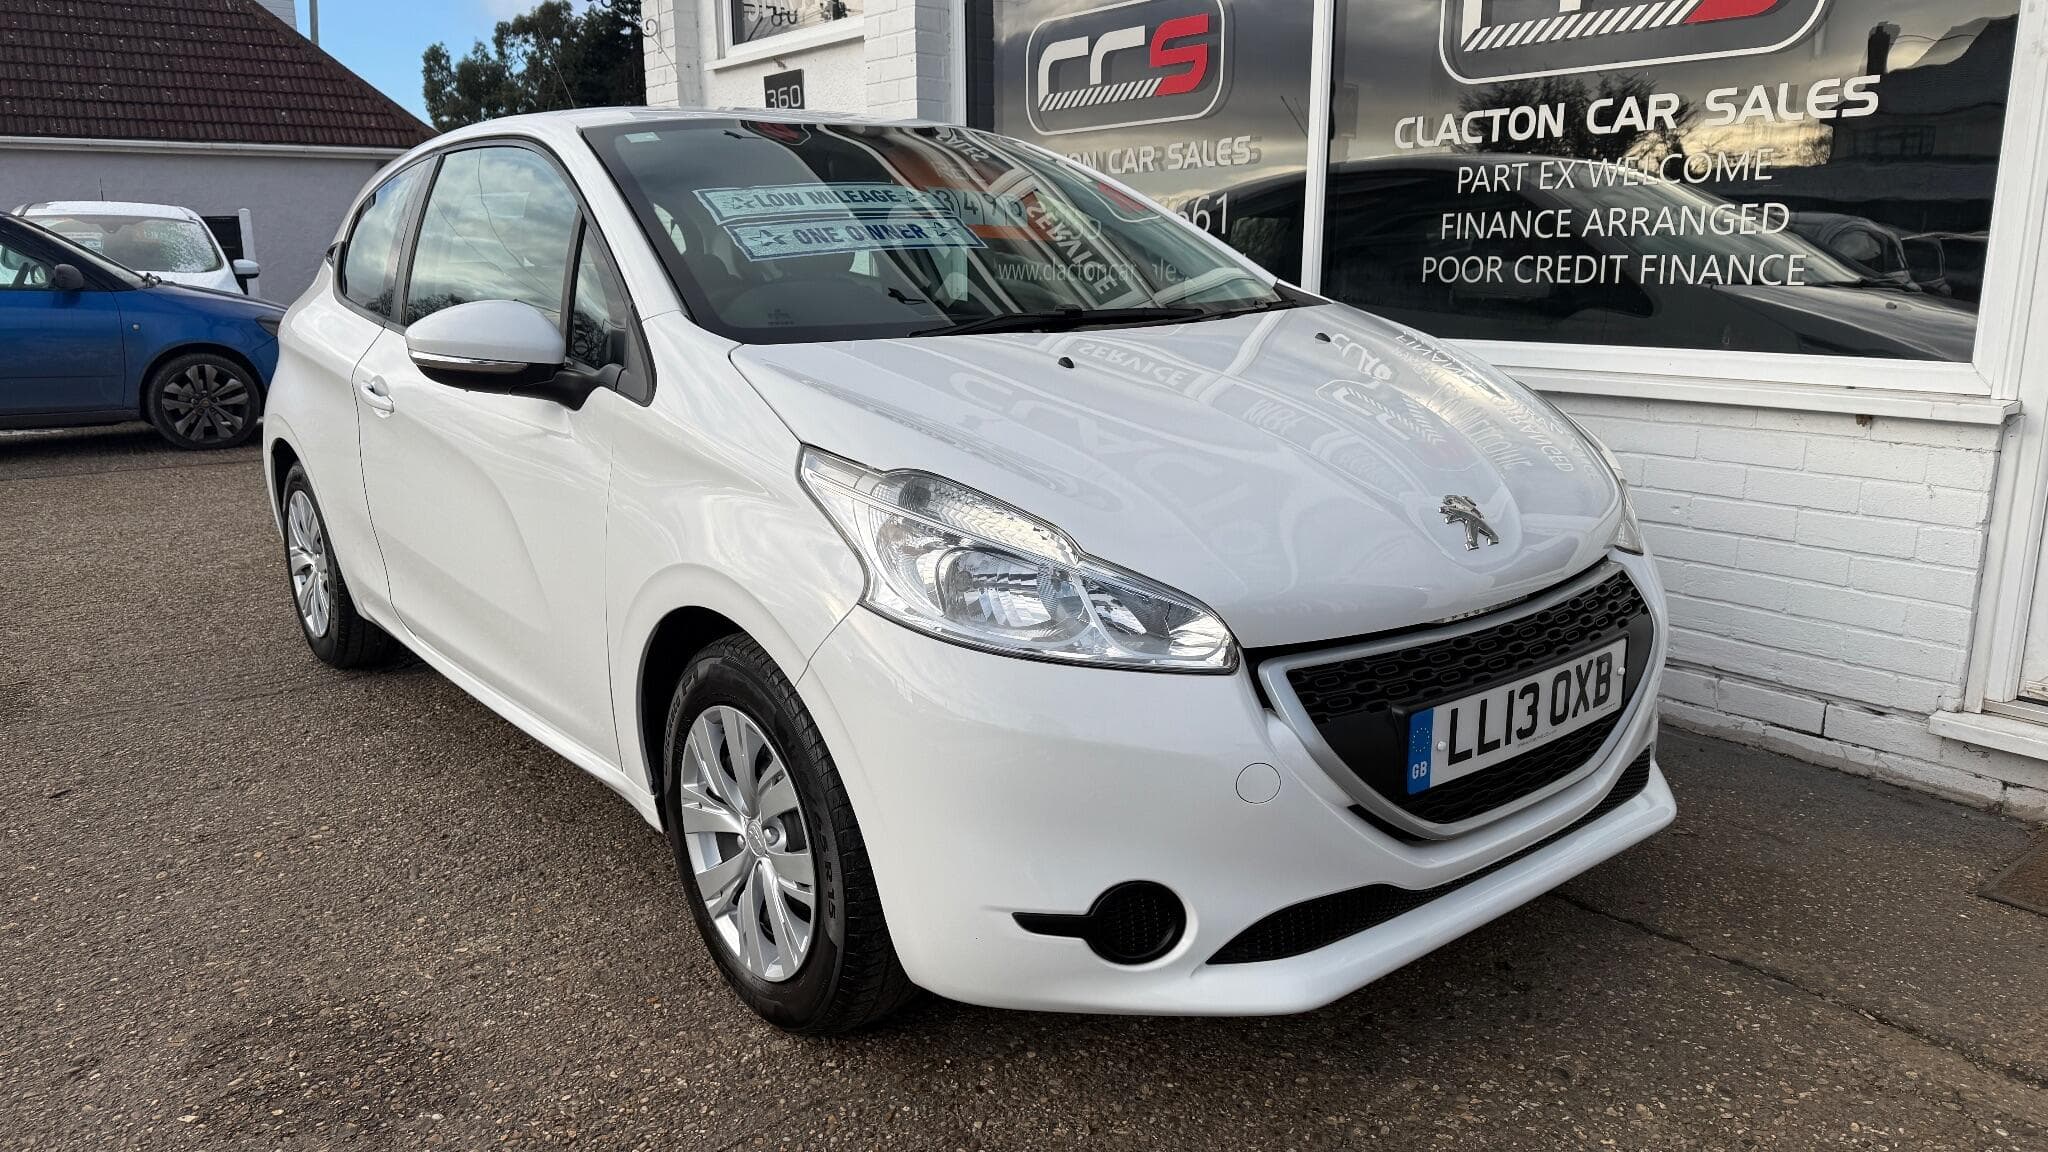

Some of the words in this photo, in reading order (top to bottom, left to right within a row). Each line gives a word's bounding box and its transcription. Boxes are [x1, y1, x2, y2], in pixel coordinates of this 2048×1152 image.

[767, 85, 801, 109] 360
[1394, 103, 1565, 151] CLACTON
[1586, 93, 1679, 136] CAR
[1704, 74, 1881, 127] SALES
[1108, 145, 1156, 174] CAR
[1167, 135, 1251, 170] SALES
[1457, 162, 1529, 194] PART
[1539, 160, 1577, 191] EX
[1588, 148, 1774, 191] WELCOME
[753, 191, 805, 208] LOW
[805, 189, 902, 205] MILEAGE
[792, 226, 845, 245] ONE
[845, 223, 930, 241] OWNER
[1441, 209, 1571, 241] FINANCE
[1582, 202, 1790, 238] ARRANGED
[1421, 255, 1504, 285] POOR
[1513, 253, 1629, 285] CREDIT
[1639, 253, 1807, 287] FINANCE
[1447, 681, 1540, 767] LL13
[1549, 651, 1613, 727] OXB
[1412, 761, 1427, 780] GB
